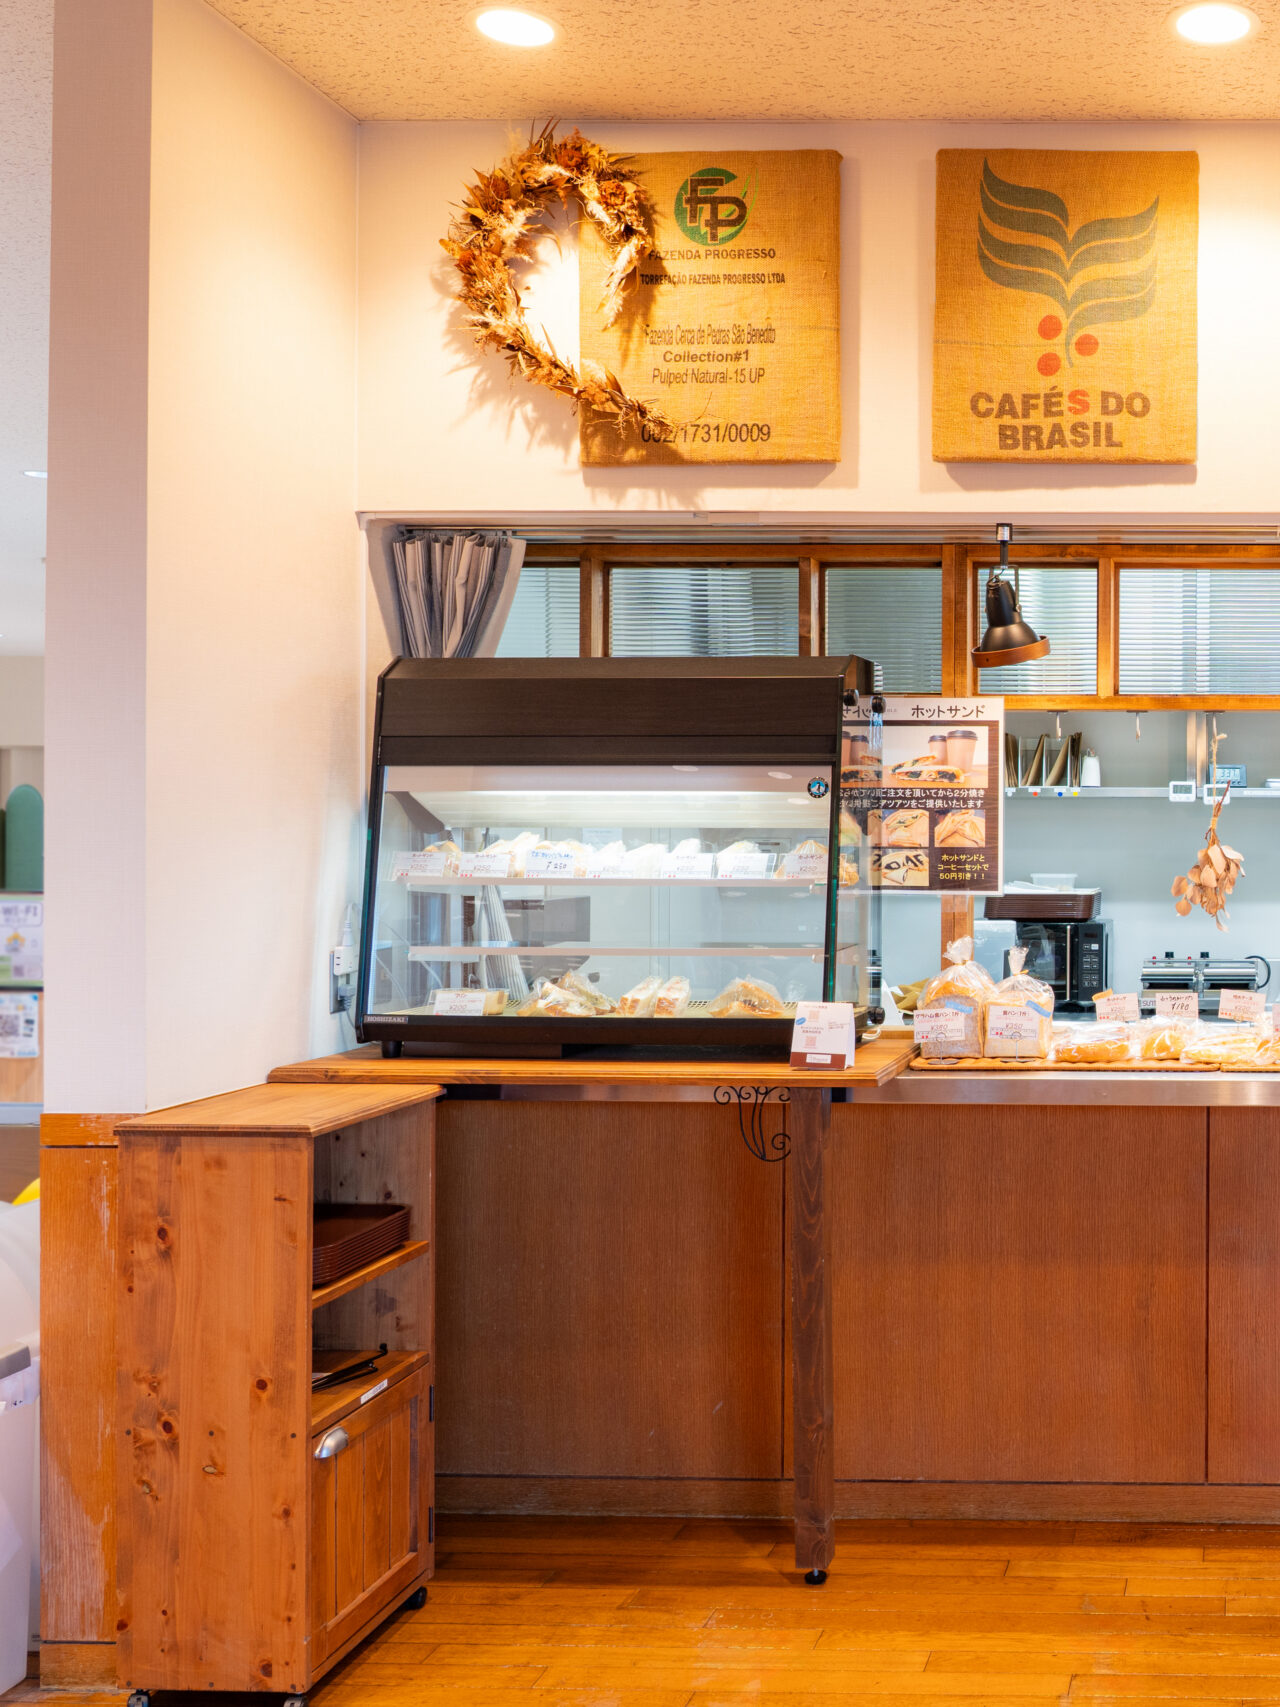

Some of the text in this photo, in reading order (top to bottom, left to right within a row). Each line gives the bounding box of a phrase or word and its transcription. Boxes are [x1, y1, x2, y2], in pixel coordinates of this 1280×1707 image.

[649, 248, 777, 261] FAZENDA PROGRESSO
[640, 272, 786, 286] TORREFAÇÃO FAZENDA PROGRESSO LTDA
[675, 323, 695, 346] Cerca
[696, 324, 705, 345] de
[707, 323, 730, 345] Pedras
[732, 322, 745, 345] São
[746, 322, 777, 345] Benedito
[663, 349, 749, 363] Collection#1
[652, 367, 688, 387] Pulped
[749, 367, 766, 384] UP
[969, 385, 1151, 419] CAFÉS DO
[998, 421, 1123, 451] BRASIL
[911, 704, 985, 718] ホットサンド
[941, 853, 985, 862] ホットサンドと
[937, 863, 990, 871] コーヒーセットで
[367, 1016, 405, 1024] HOSHIZAKI
